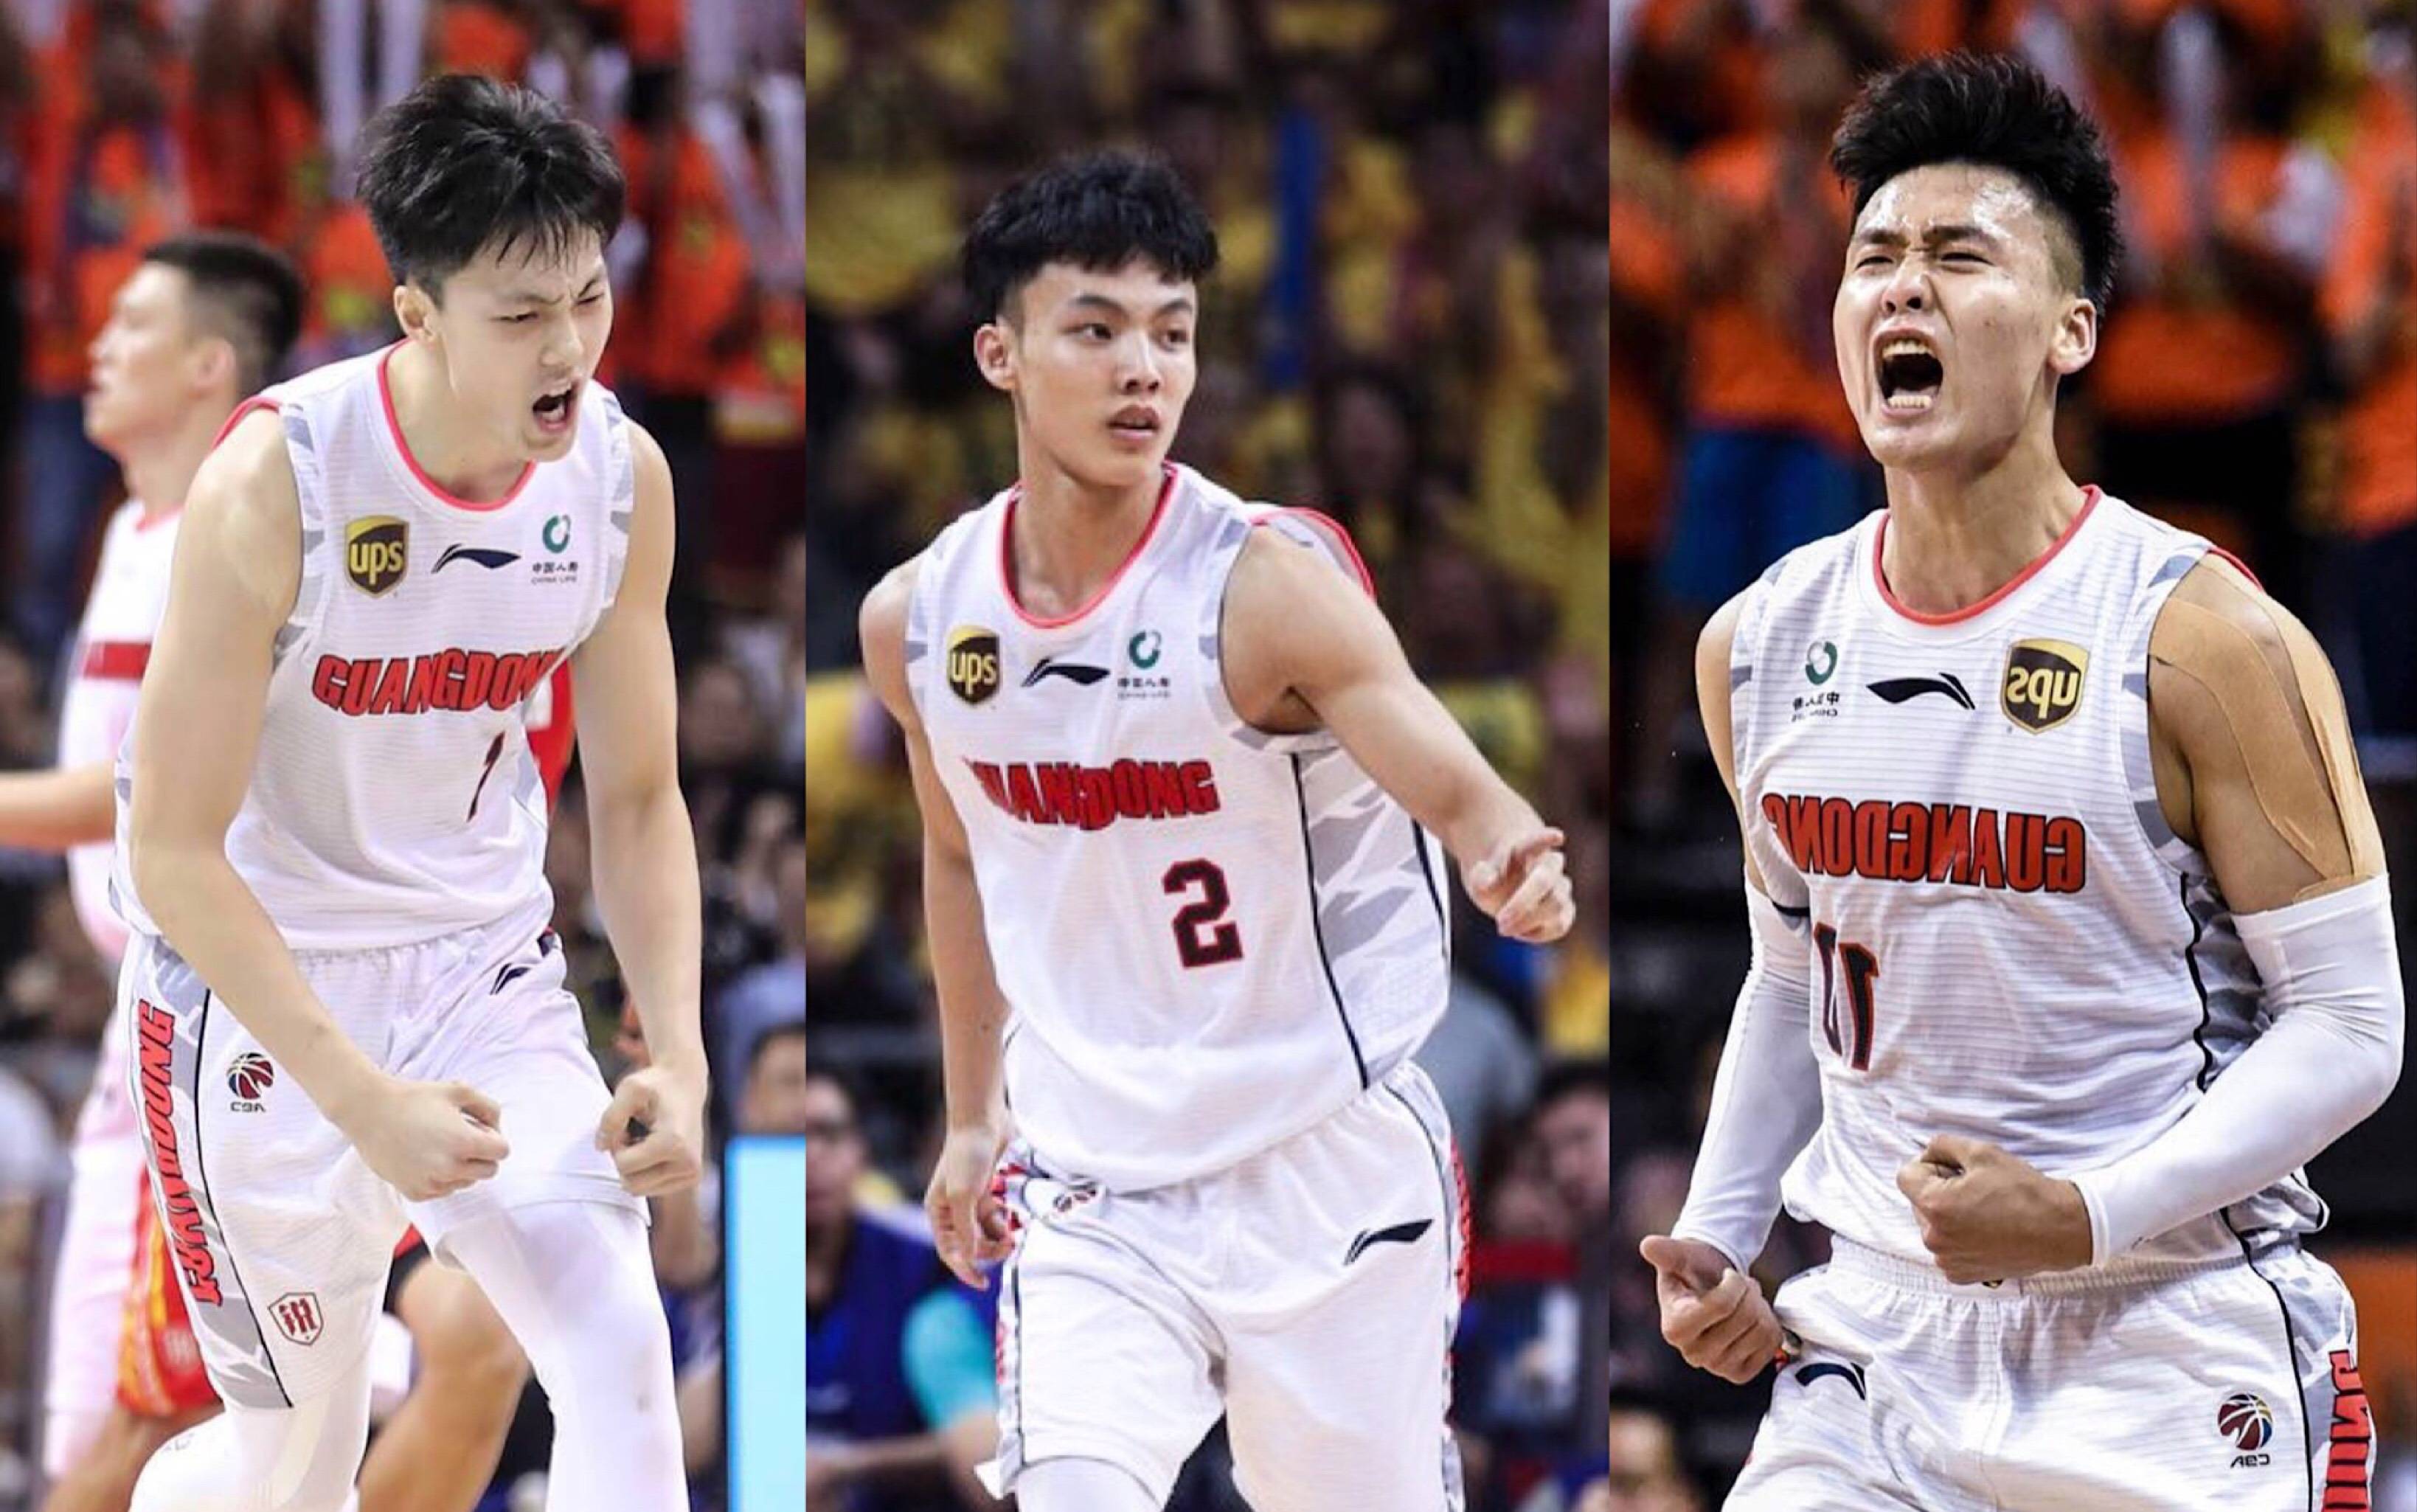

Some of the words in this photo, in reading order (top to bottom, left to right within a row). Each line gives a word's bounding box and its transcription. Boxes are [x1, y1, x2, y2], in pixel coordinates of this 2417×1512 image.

[349, 541, 404, 585] ups
[313, 648, 565, 716] GUANGDON
[949, 651, 999, 695] ups
[1162, 858, 1243, 969] 2
